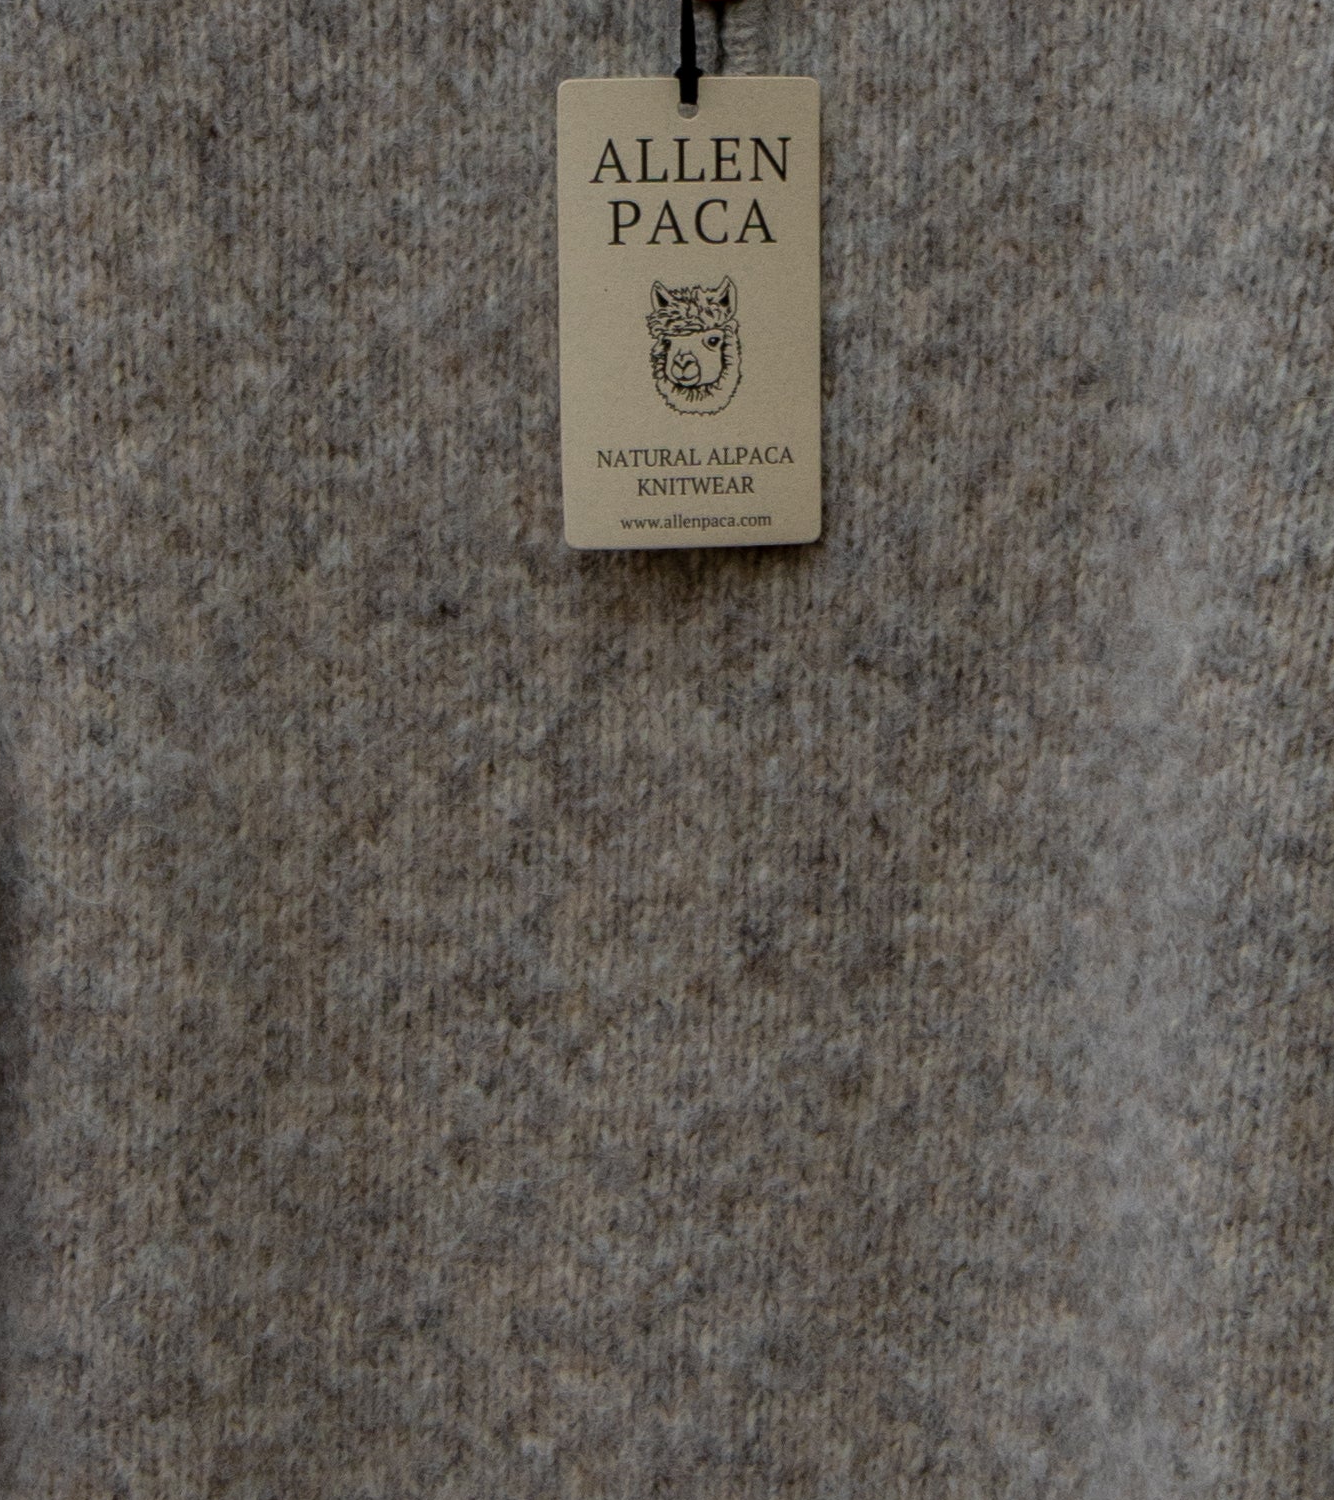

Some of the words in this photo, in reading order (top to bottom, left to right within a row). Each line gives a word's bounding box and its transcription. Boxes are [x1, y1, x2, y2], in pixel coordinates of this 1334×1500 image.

[589, 137, 791, 183] ALLEN
[607, 199, 777, 245] PACA
[597, 448, 702, 468] NATURAL
[707, 446, 794, 465] ALPACA
[637, 477, 755, 496] KNITWEAR
[620, 515, 772, 531] www.allenpaca.com
